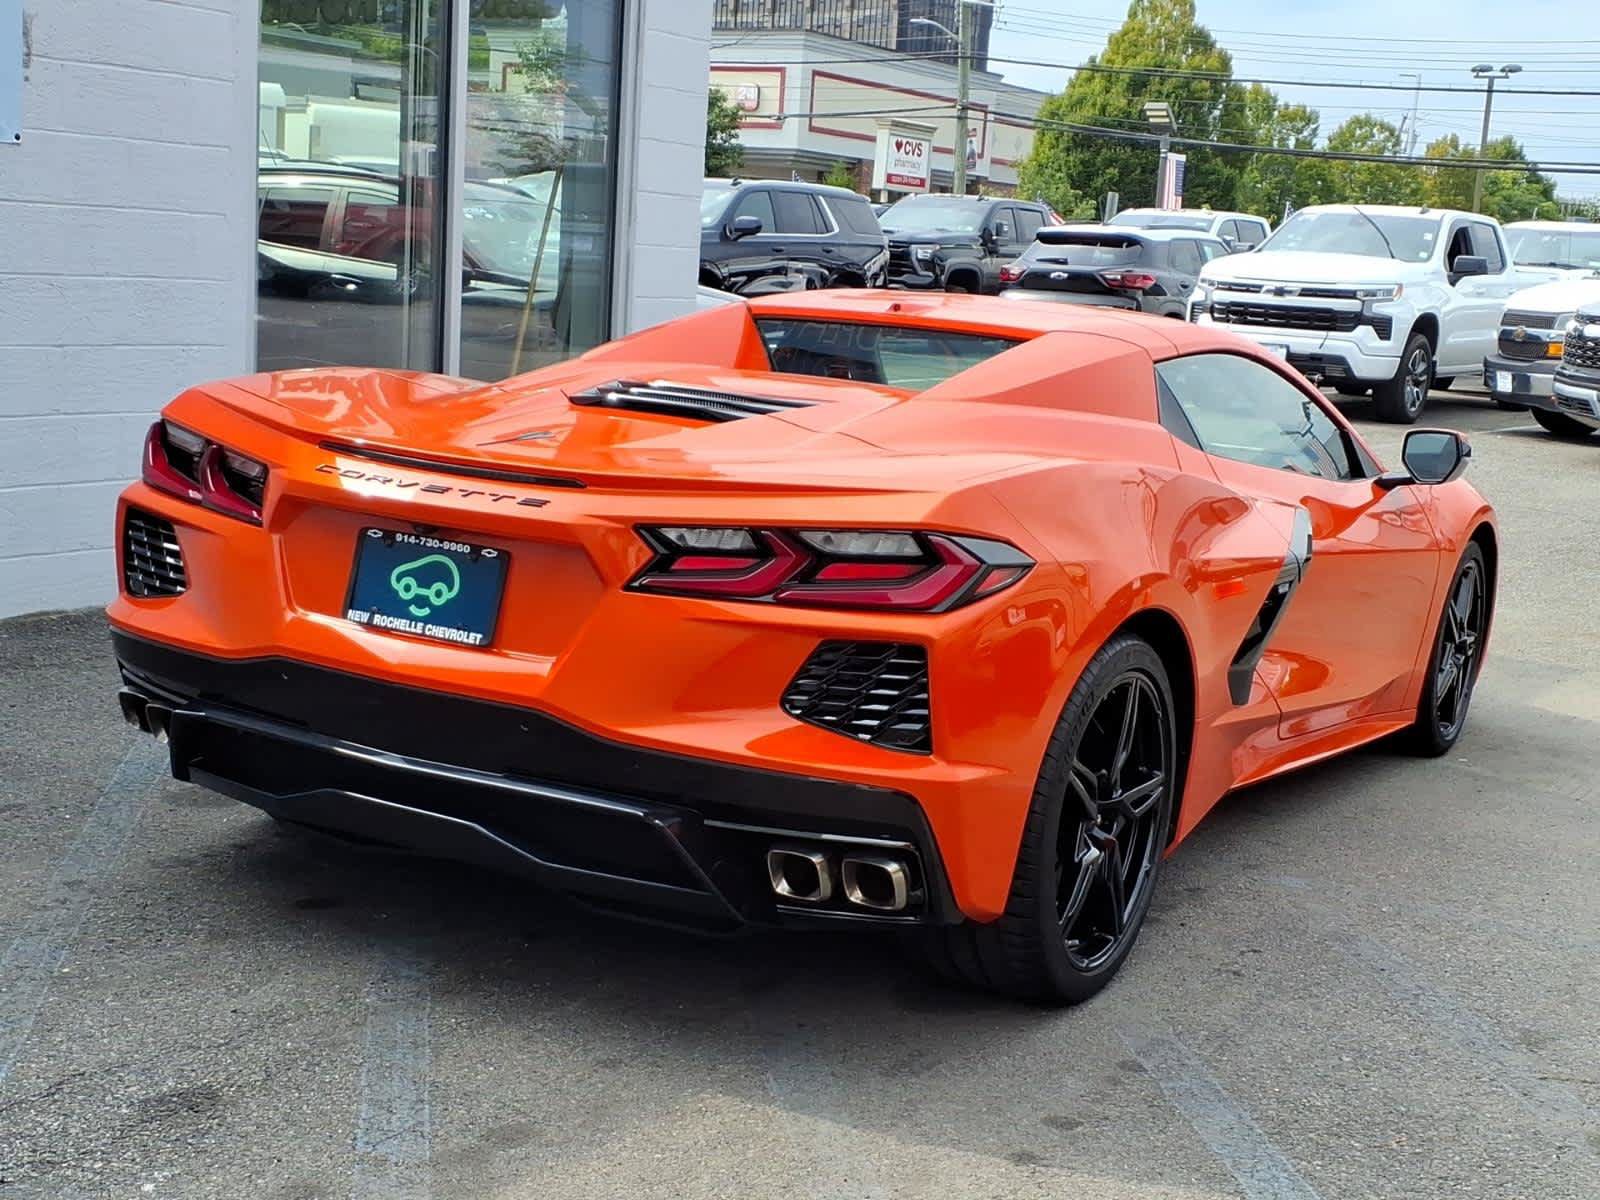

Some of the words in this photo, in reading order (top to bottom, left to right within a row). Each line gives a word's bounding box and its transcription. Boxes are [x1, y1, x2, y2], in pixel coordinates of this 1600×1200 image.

[904, 140, 922, 157] CVS
[315, 463, 552, 508] CORVETTE
[395, 533, 471, 553] 914-730-9960
[347, 608, 370, 623] NEW
[373, 614, 424, 634] ROCHELLE
[425, 624, 483, 645] CHEVROLET
